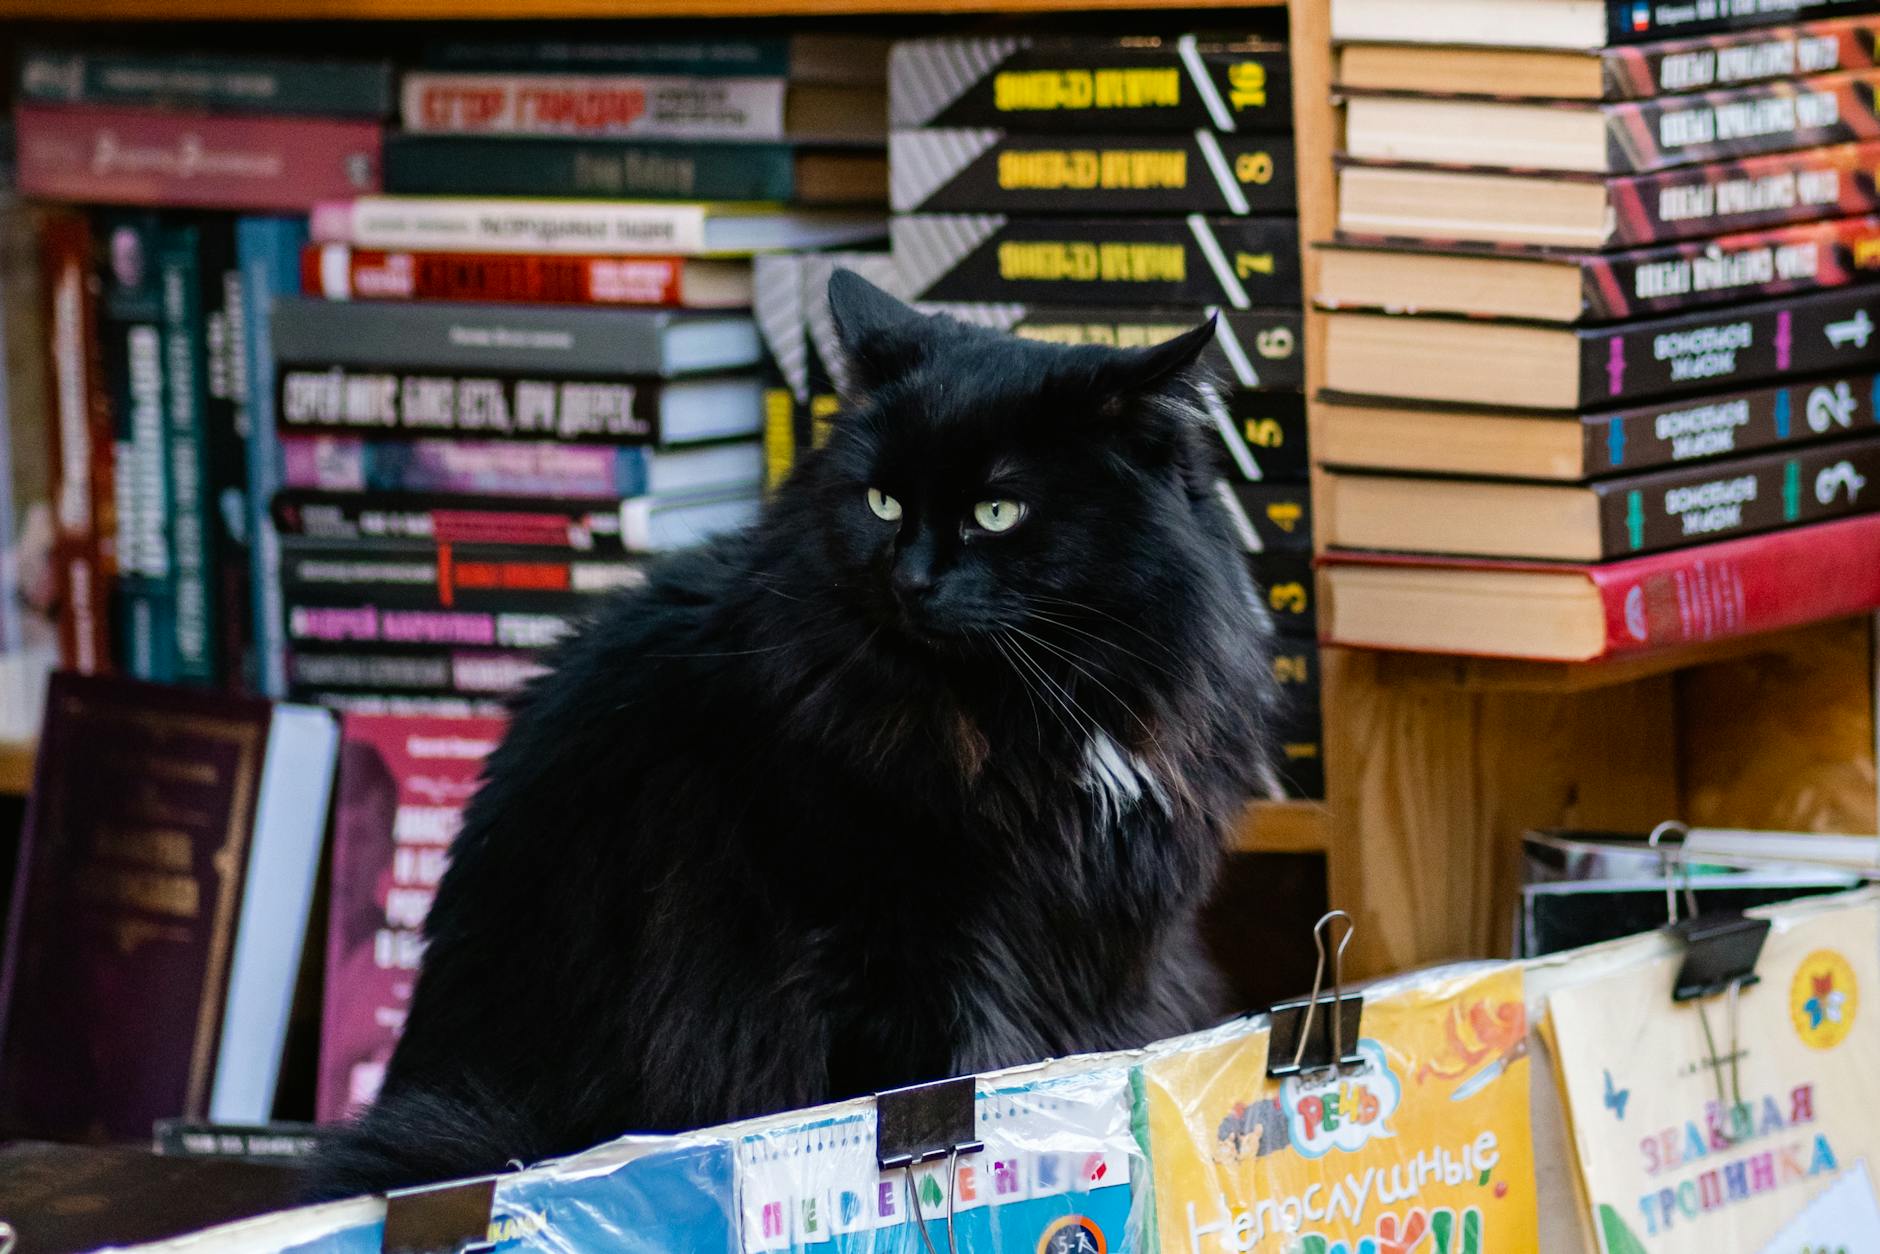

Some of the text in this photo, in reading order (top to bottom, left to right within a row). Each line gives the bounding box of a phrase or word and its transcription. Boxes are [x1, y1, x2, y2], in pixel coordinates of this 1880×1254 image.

[1227, 61, 1268, 113] 10
[1235, 151, 1274, 186] 8
[1236, 252, 1275, 281] 7
[1256, 326, 1295, 361] 6
[1824, 308, 1874, 350] 1
[1806, 380, 1858, 434] 2
[1245, 417, 1283, 449] 5
[1815, 460, 1867, 505] 3
[1266, 502, 1302, 534] 4
[1269, 582, 1307, 615] 3
[1273, 655, 1308, 685] 2
[1297, 1082, 1380, 1141] РЕЧЬ
[1638, 1132, 1838, 1237] ТРОПИНКА
